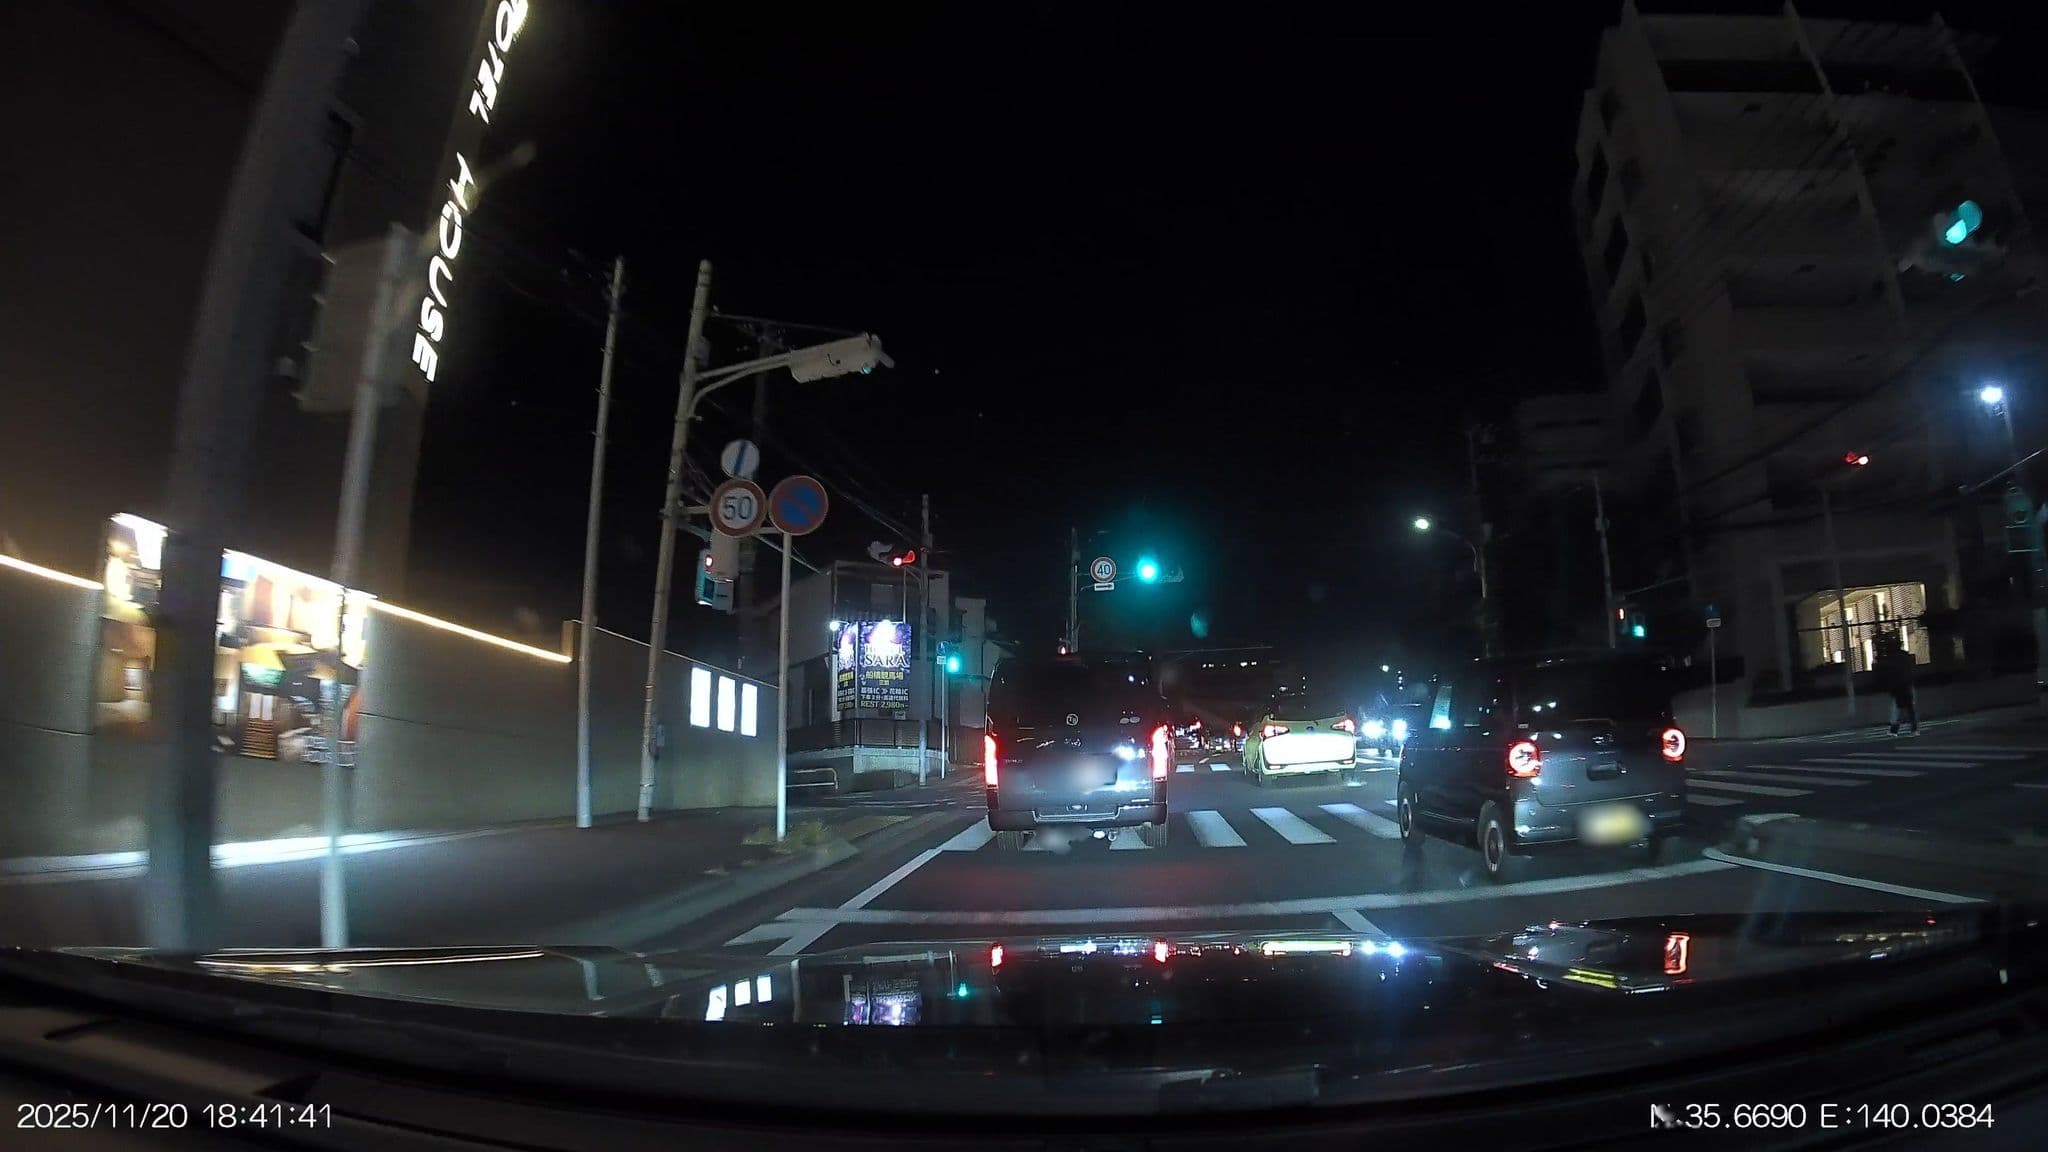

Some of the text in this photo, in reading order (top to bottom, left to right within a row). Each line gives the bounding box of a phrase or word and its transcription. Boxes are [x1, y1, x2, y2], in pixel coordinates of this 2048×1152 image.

[412, 151, 474, 382] HOUSE
[723, 496, 752, 520] 50
[1097, 564, 1110, 575] 40
[865, 654, 908, 667] SARA
[860, 700, 880, 708] REST
